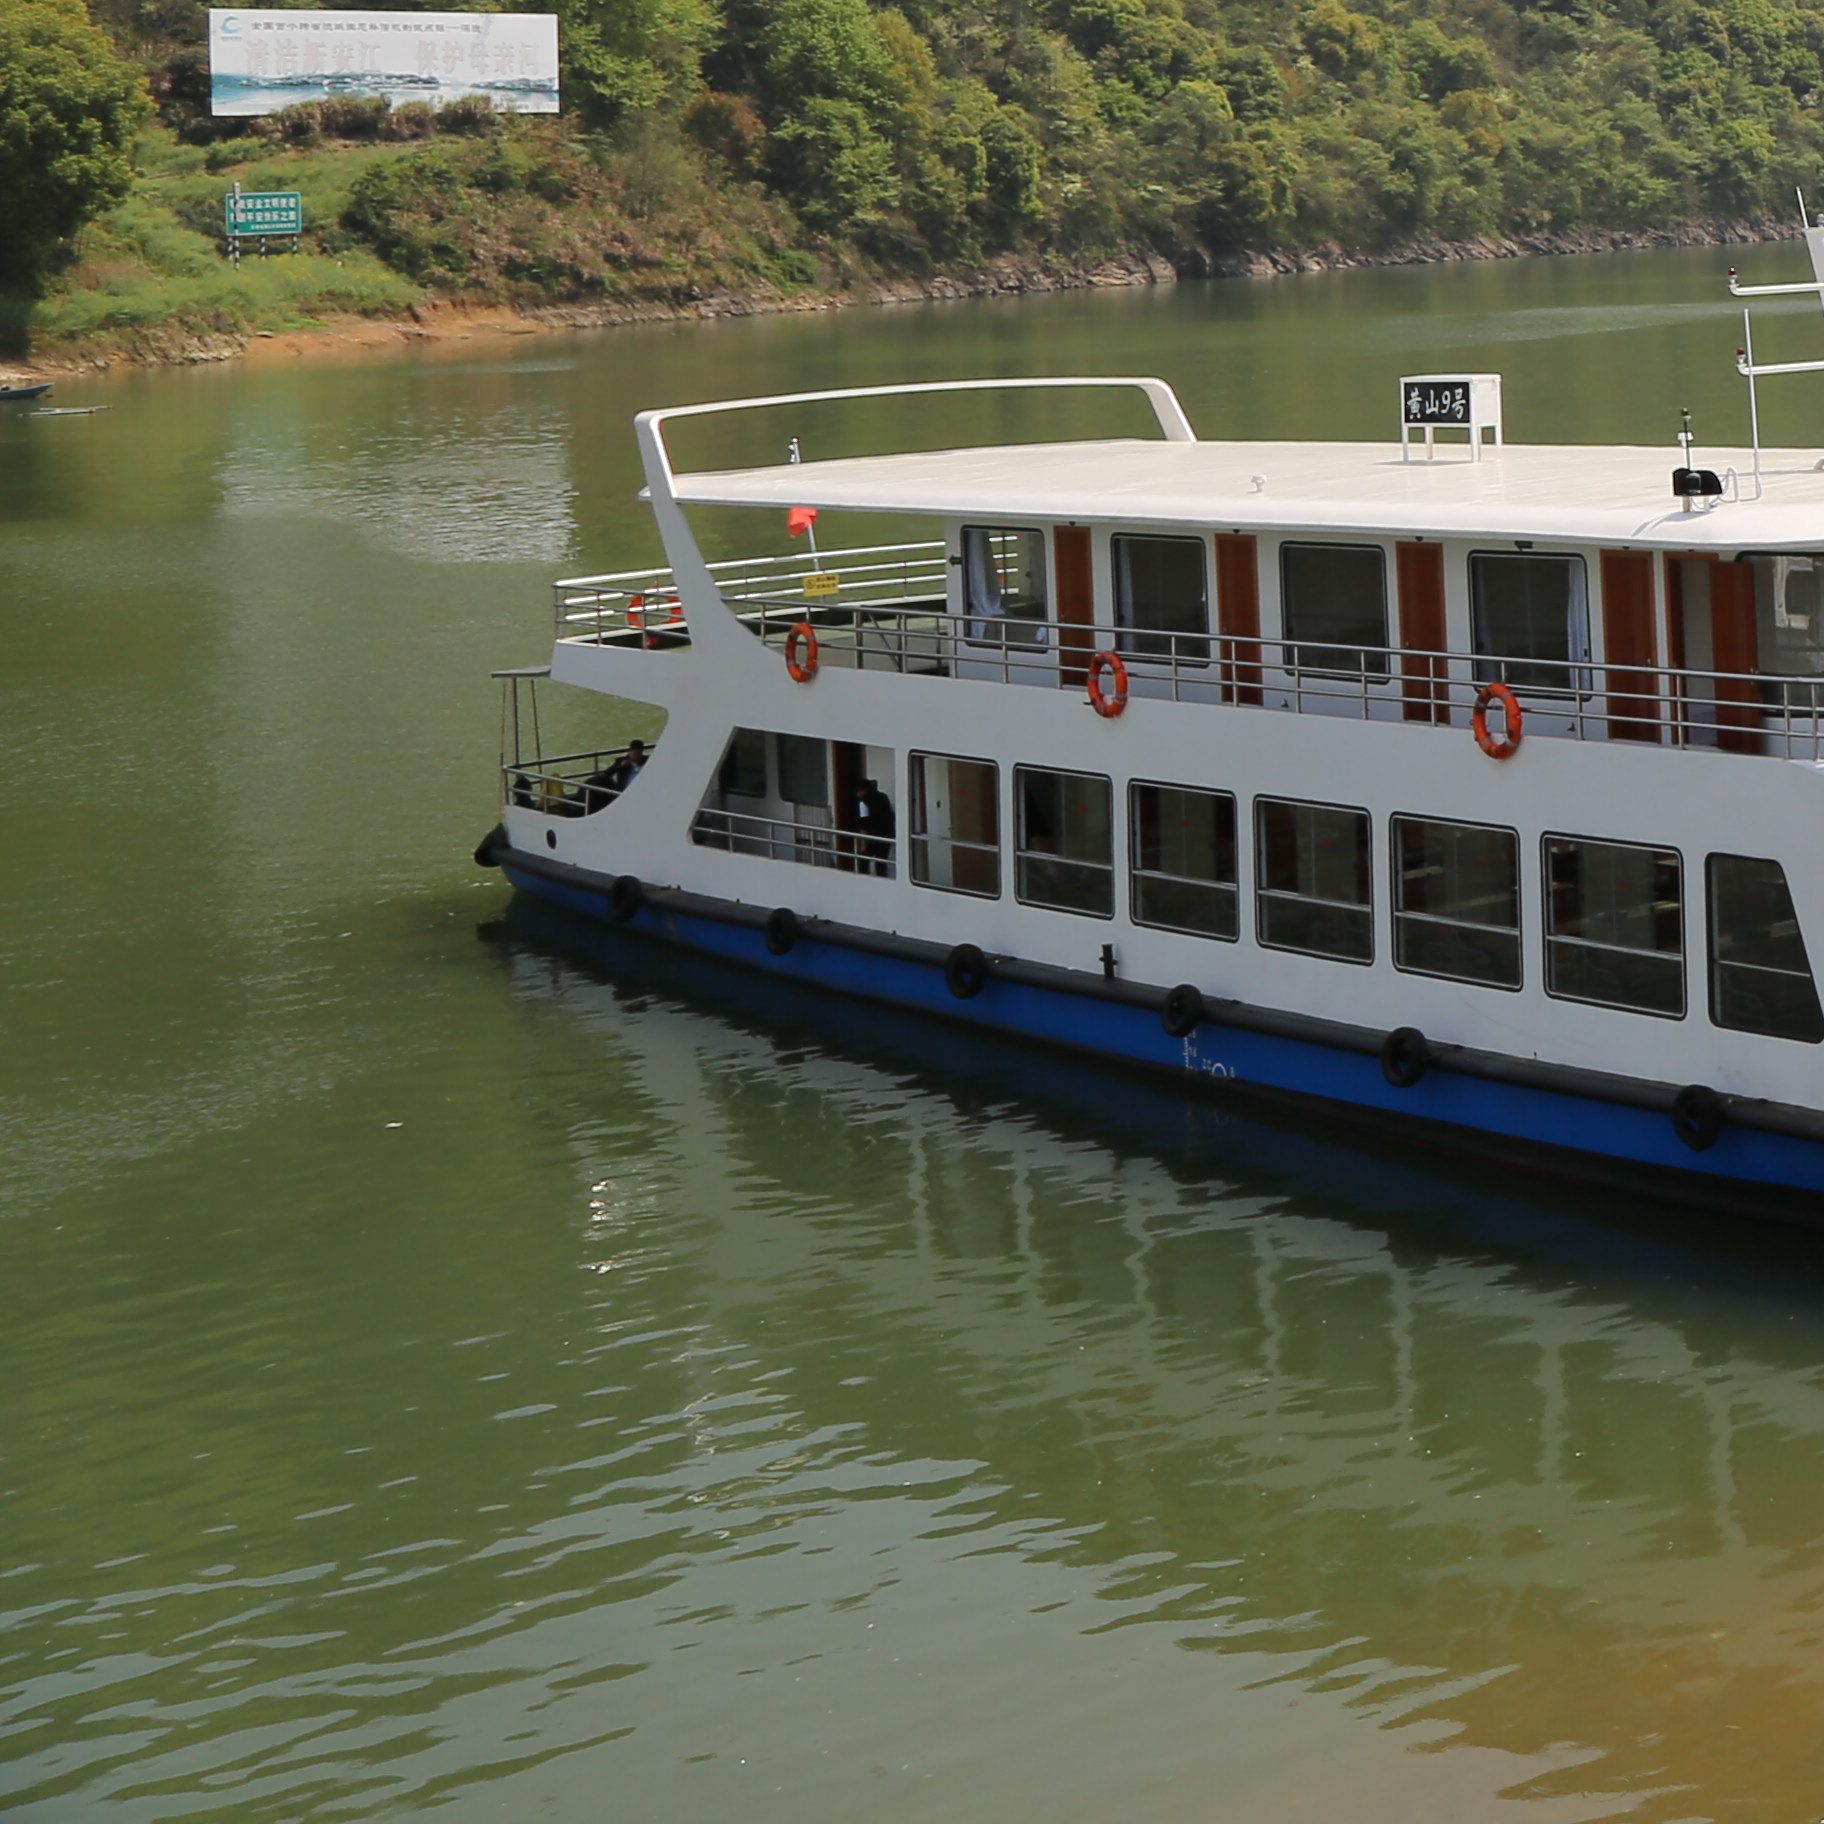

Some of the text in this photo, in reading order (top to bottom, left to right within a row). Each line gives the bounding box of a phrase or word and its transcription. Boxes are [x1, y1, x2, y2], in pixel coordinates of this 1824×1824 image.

[246, 38, 540, 75] 清洁新安江 保护母亲河
[1406, 386, 1467, 420] 黄山9号
